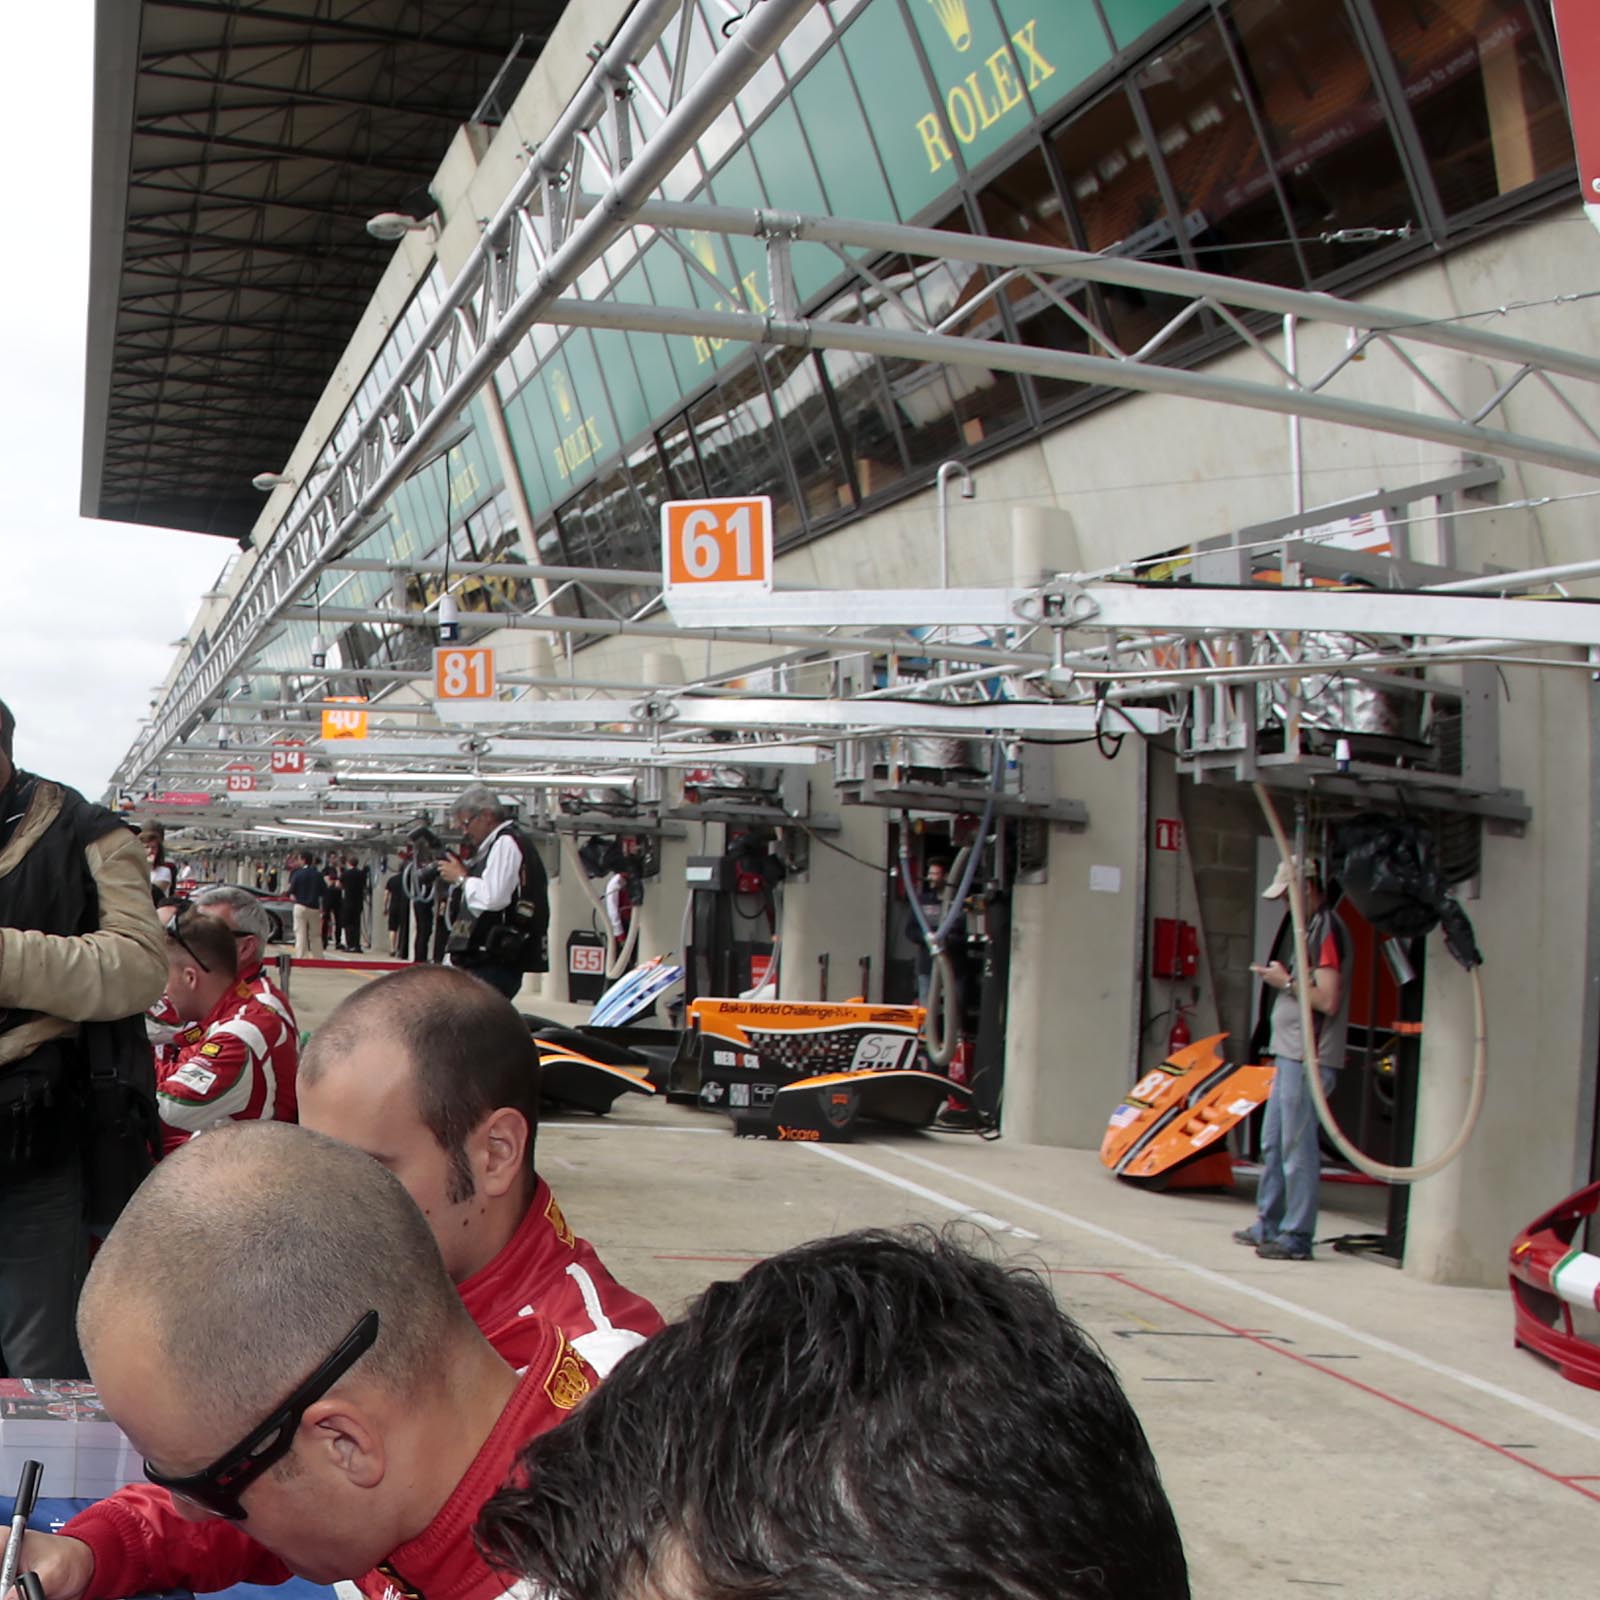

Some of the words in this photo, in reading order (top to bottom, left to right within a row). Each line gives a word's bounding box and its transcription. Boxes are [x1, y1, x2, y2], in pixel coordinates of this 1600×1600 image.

[916, 19, 1056, 173] ROLEX
[682, 507, 751, 579] 61
[443, 652, 486, 696] 81
[574, 951, 600, 970] 55
[719, 1003, 746, 1014] Baku
[749, 1003, 780, 1016] World
